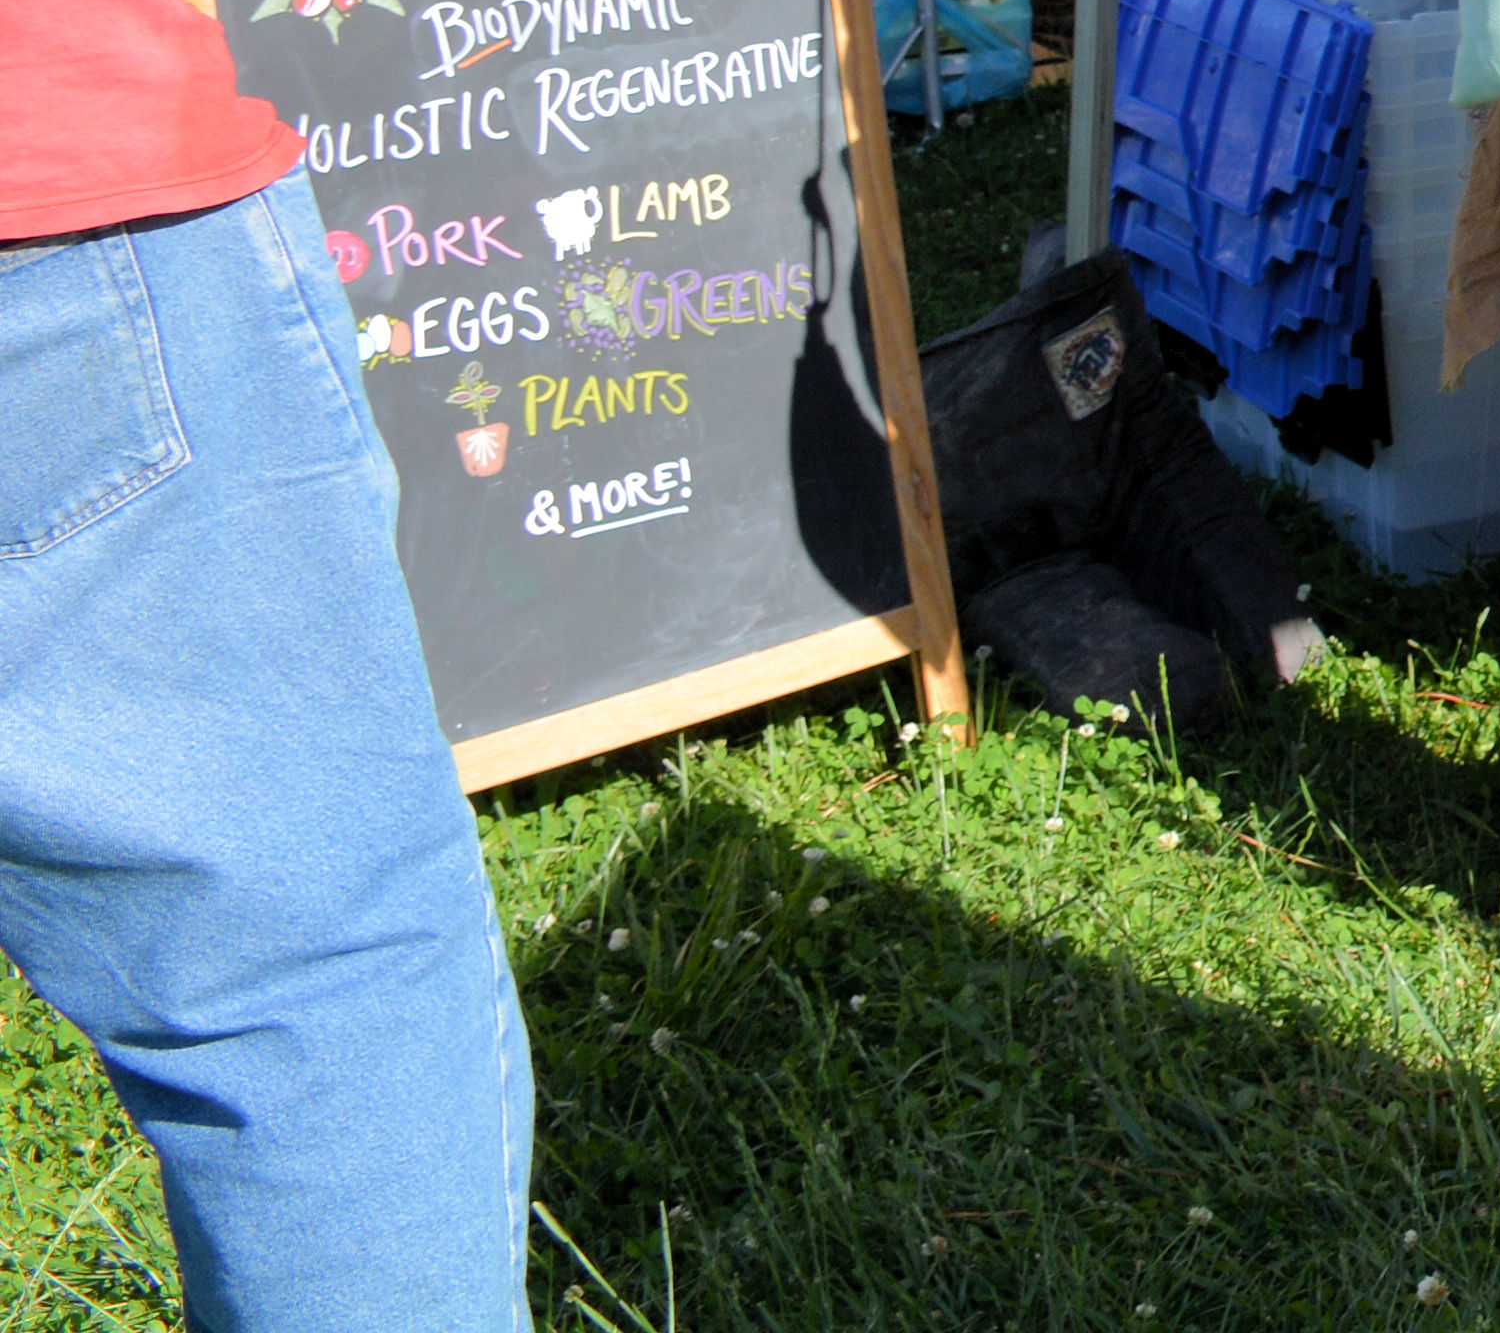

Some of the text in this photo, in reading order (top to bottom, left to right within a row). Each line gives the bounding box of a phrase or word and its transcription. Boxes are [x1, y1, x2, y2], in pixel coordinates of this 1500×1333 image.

[534, 33, 824, 155] REGENERATIVE
[366, 174, 733, 277] PORK LAMB
[411, 263, 815, 362] EGGS GREENS
[517, 369, 690, 437] PLANTS
[524, 457, 693, 535] & MORE!
